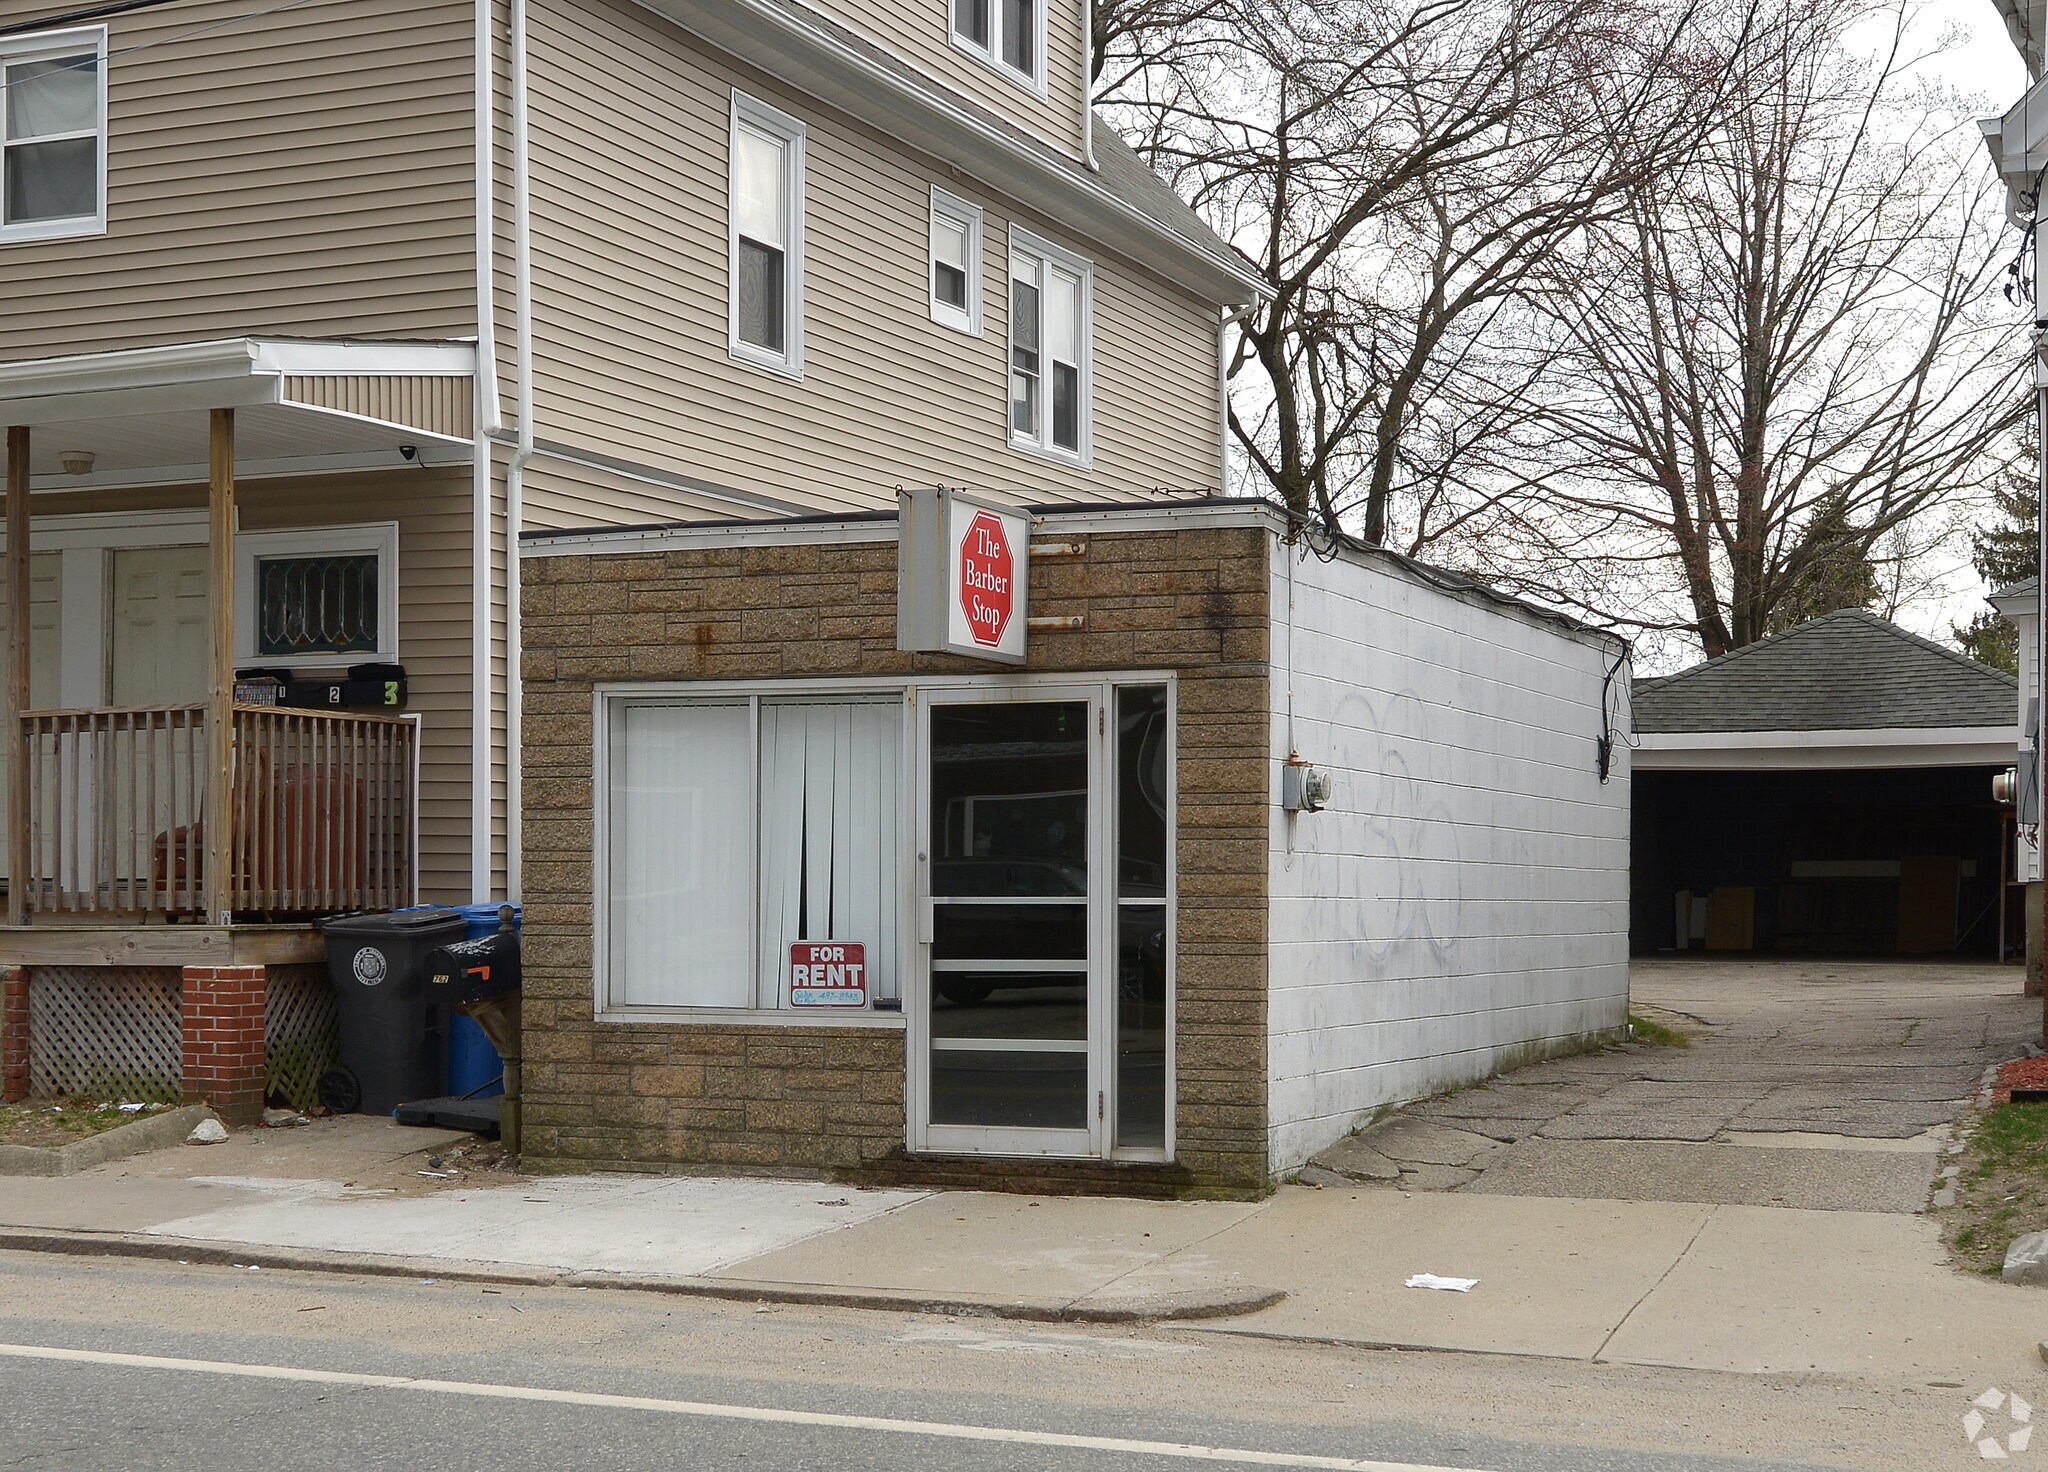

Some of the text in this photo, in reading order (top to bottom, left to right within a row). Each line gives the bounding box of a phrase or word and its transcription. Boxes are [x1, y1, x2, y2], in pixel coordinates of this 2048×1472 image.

[975, 527, 1000, 559] The
[965, 559, 1008, 594] Barber
[972, 594, 1000, 635] Stop
[279, 687, 285, 697] 1
[330, 688, 339, 702] 2
[384, 681, 399, 705] 3
[810, 946, 845, 962] FOR
[792, 964, 863, 987] RENT
